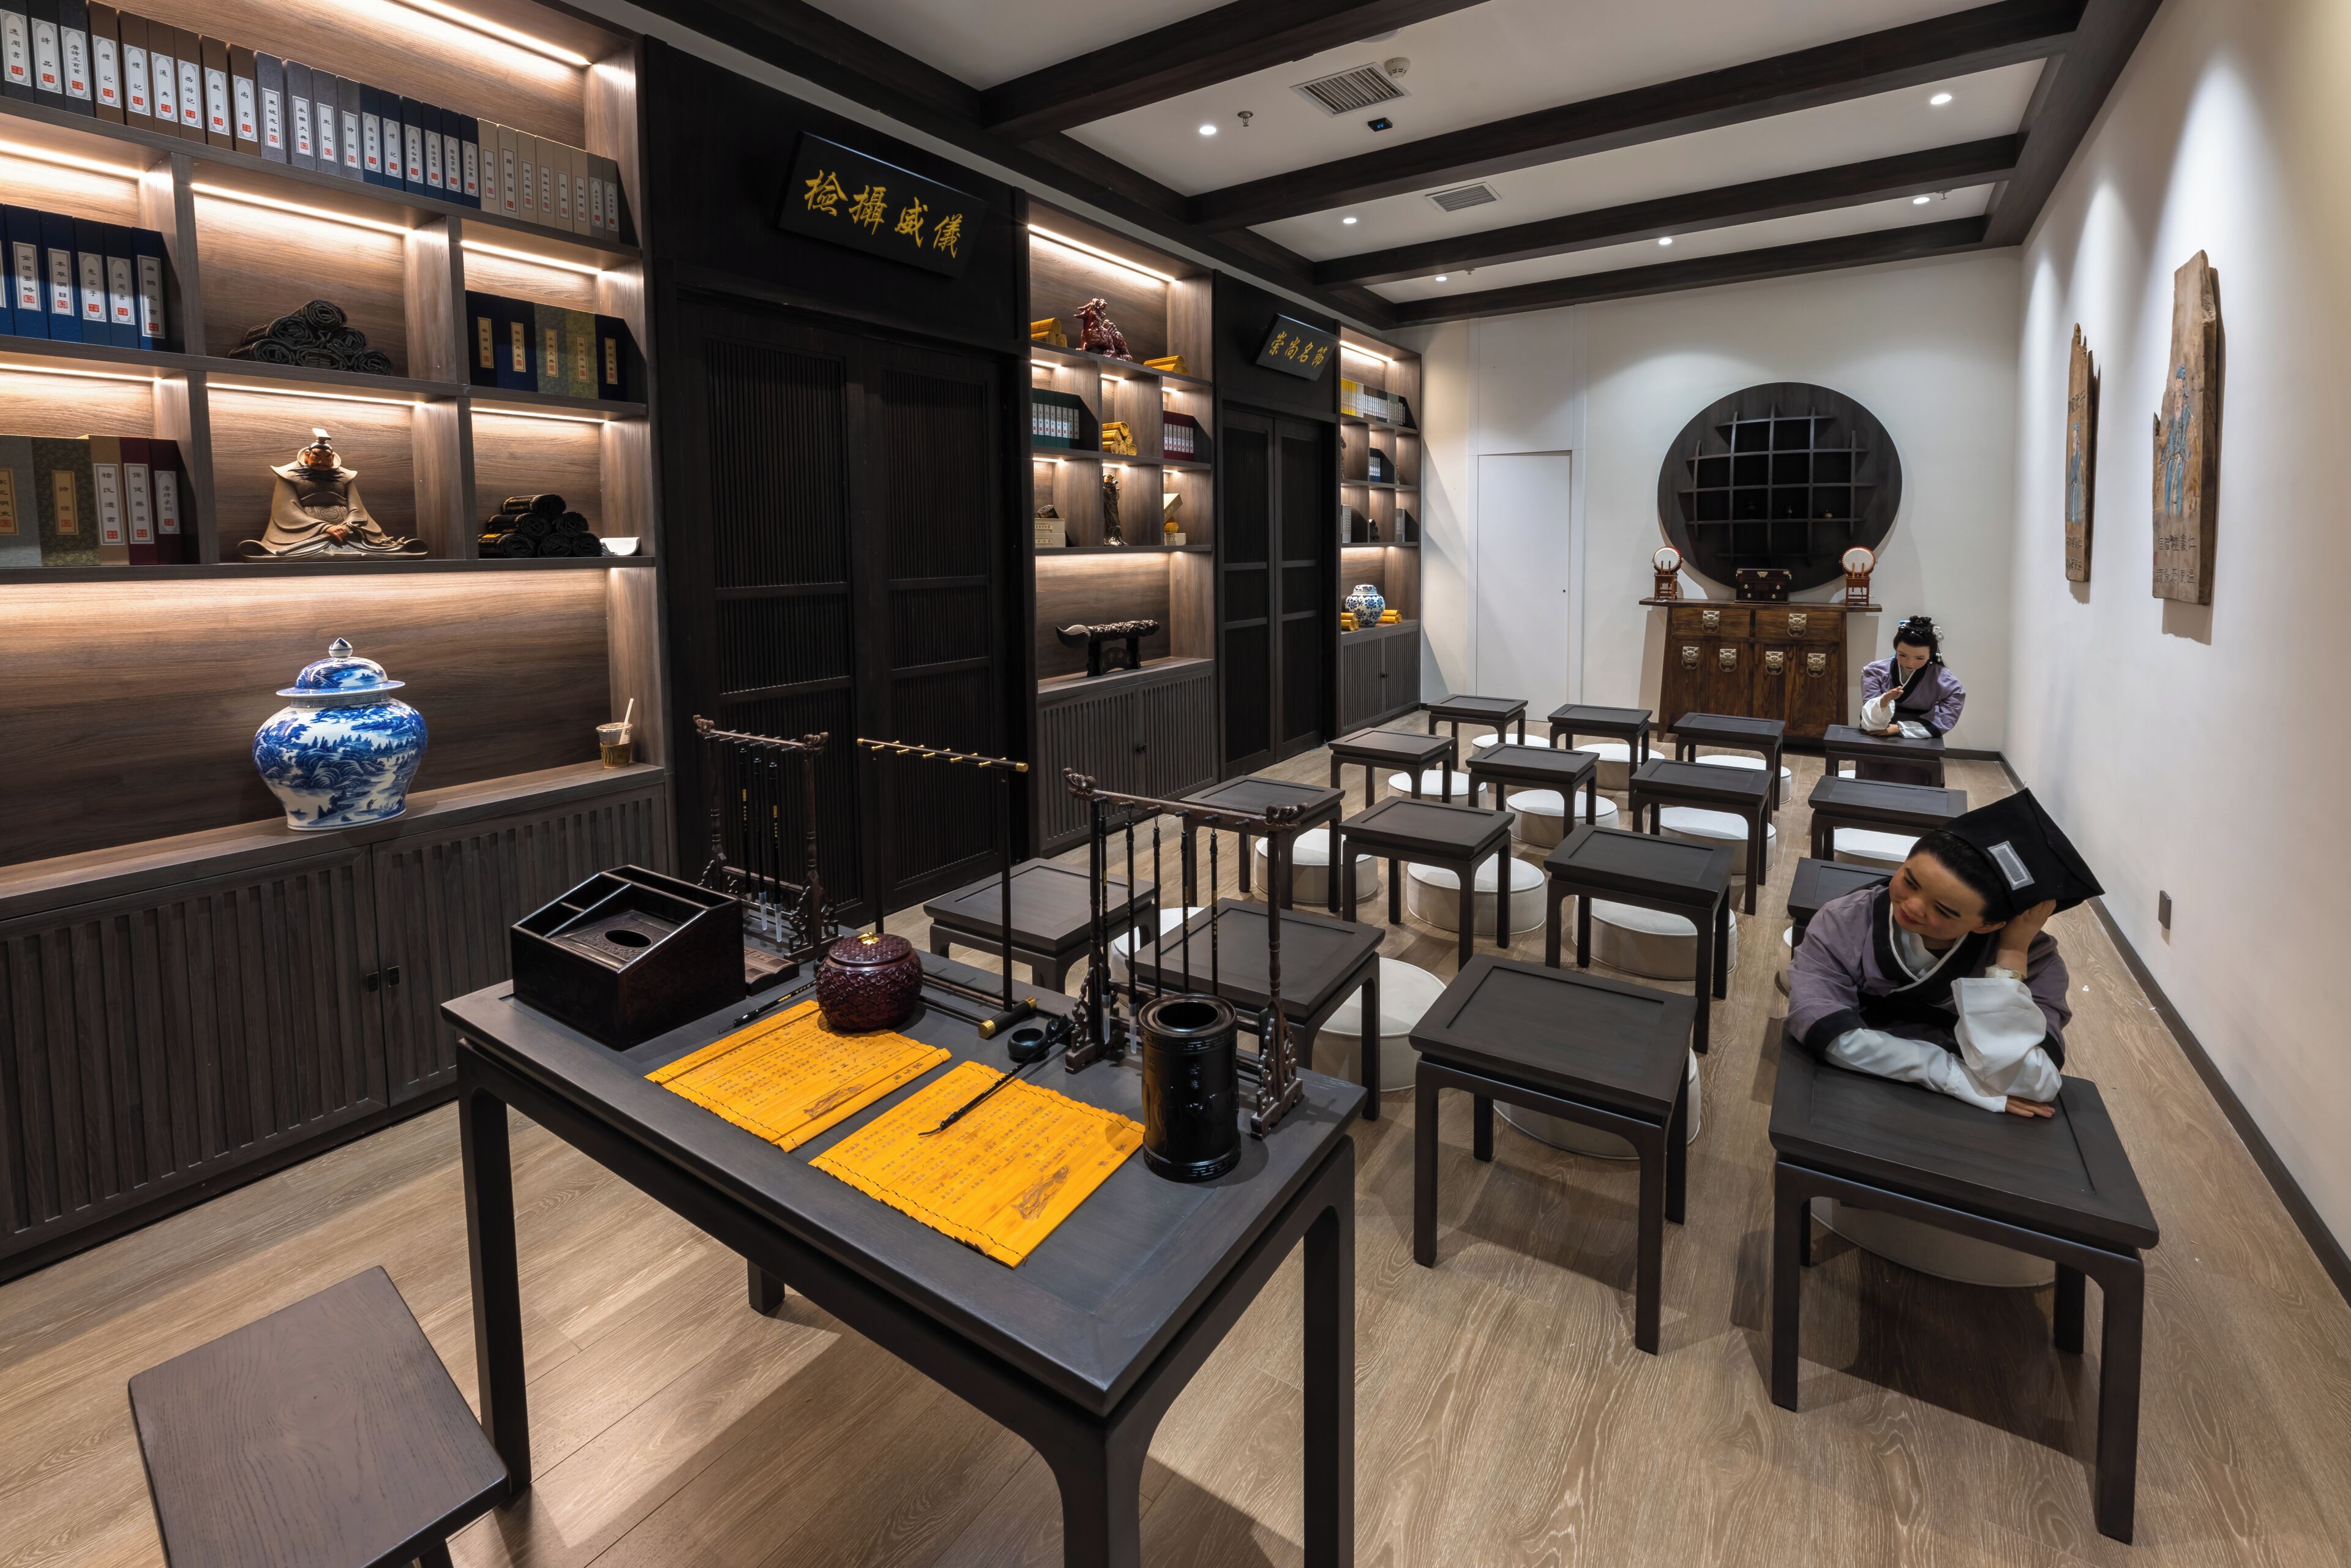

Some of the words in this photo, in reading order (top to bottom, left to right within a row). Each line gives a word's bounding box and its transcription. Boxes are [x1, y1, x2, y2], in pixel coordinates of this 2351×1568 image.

[40, 37, 53, 67] 詩品
[70, 44, 81, 74] 唐詩三百首
[101, 53, 113, 83] 禮記
[132, 62, 143, 91] 禮記
[159, 69, 170, 98] 通典
[241, 91, 250, 118] 尚書
[268, 99, 278, 133] 東坡志林
[298, 107, 308, 140] 永樂大典
[322, 119, 332, 142] 史記
[88, 268, 97, 297] 鬼谷子
